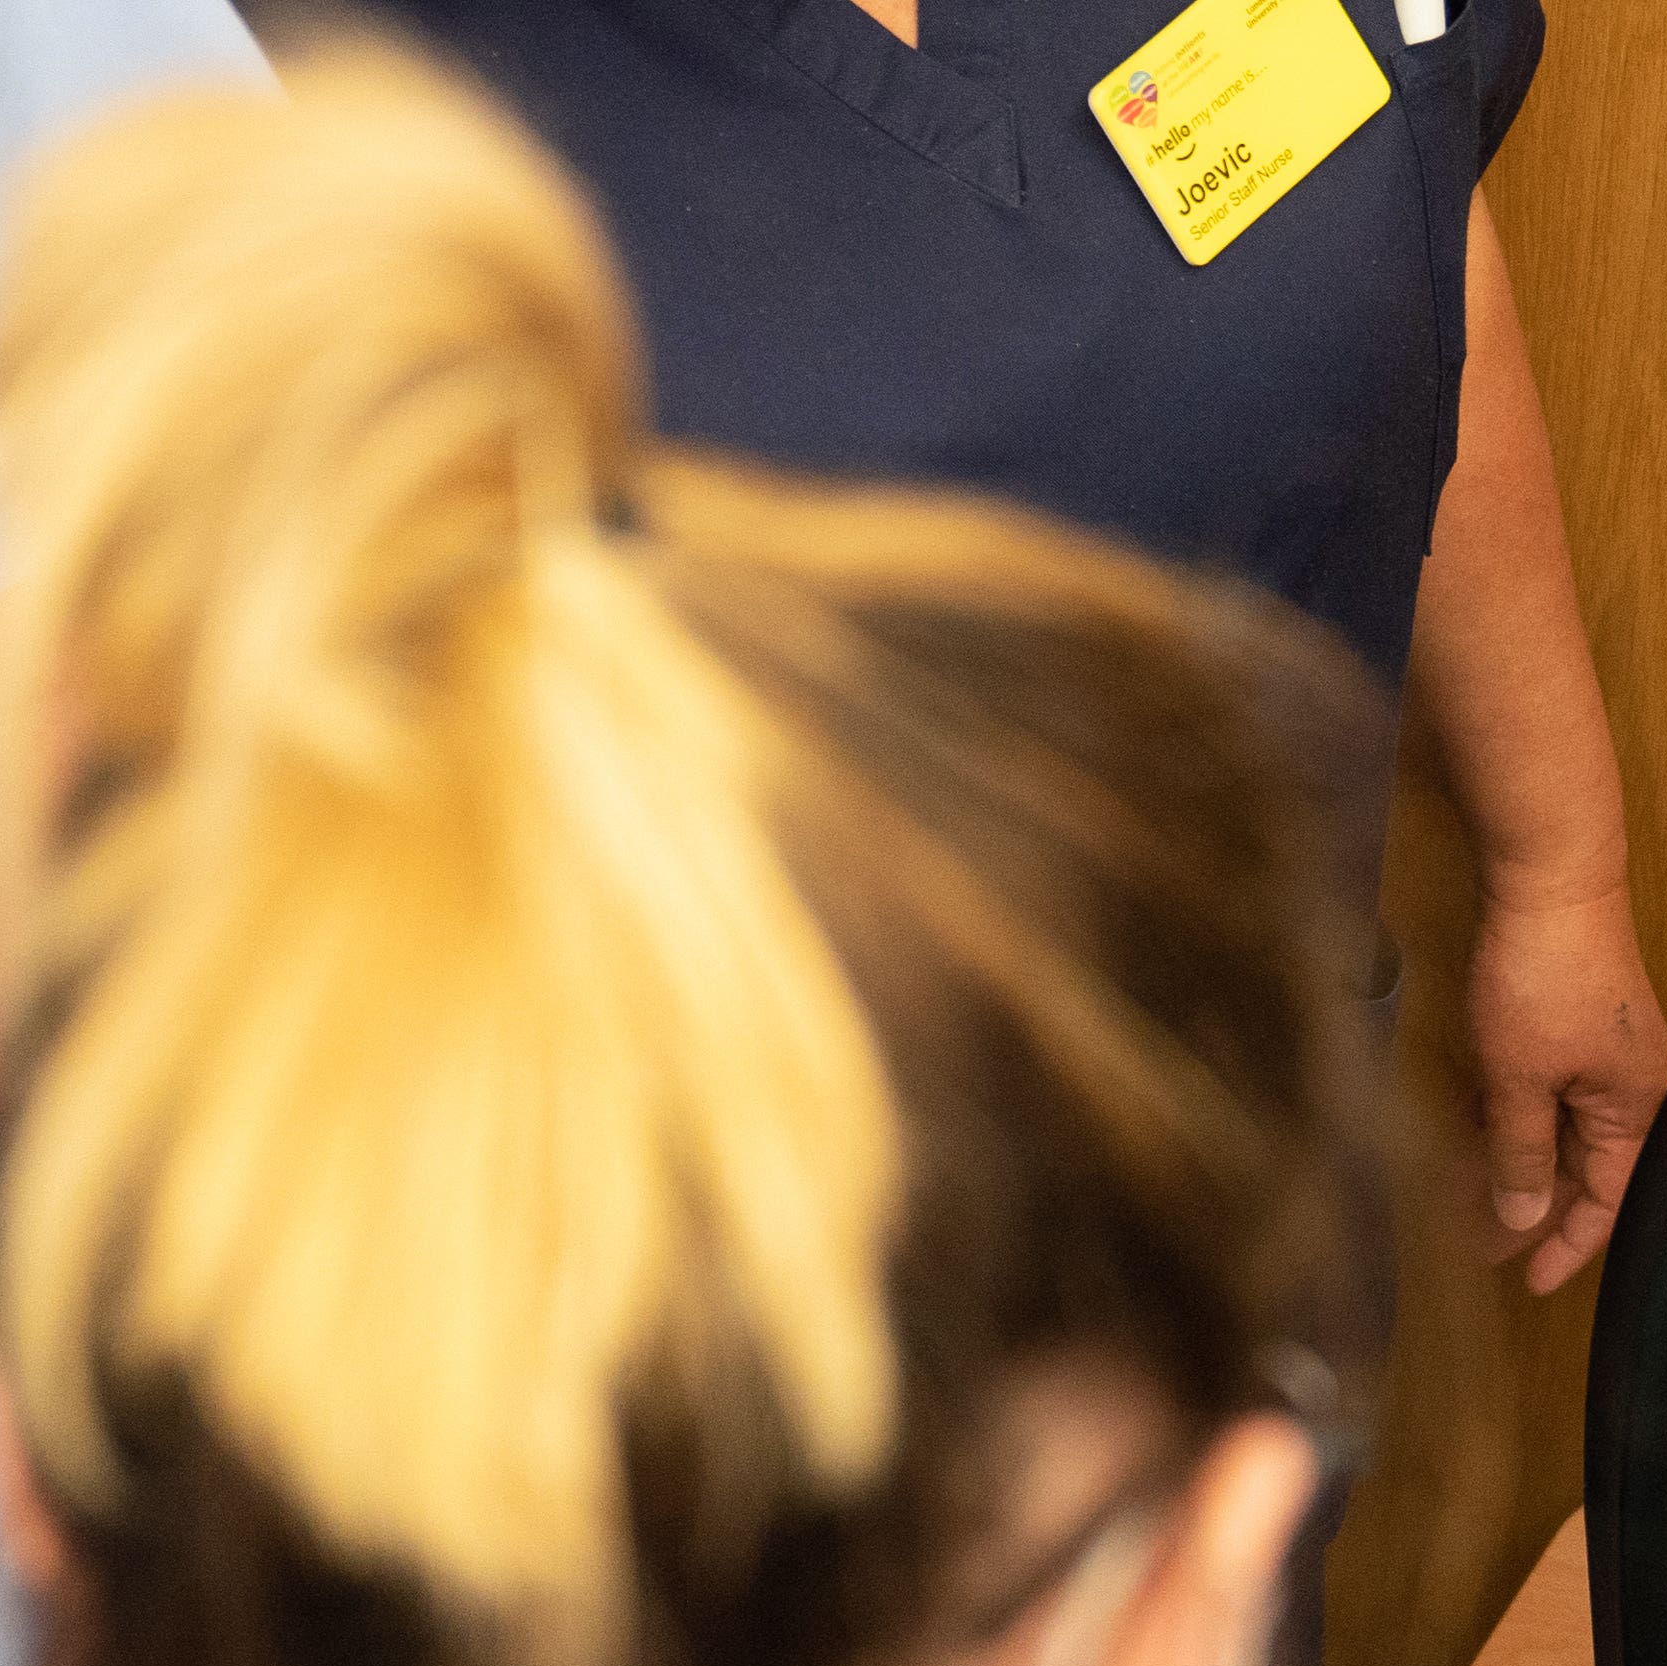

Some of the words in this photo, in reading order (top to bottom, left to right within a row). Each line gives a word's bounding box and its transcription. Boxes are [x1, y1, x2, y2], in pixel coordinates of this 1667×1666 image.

[1190, 107, 1212, 126] my
[1210, 78, 1246, 113] name
[1176, 143, 1252, 216] Joevic
[1189, 202, 1230, 241] Senior
[1228, 174, 1259, 208] Staff
[1256, 148, 1294, 184] Nurse
